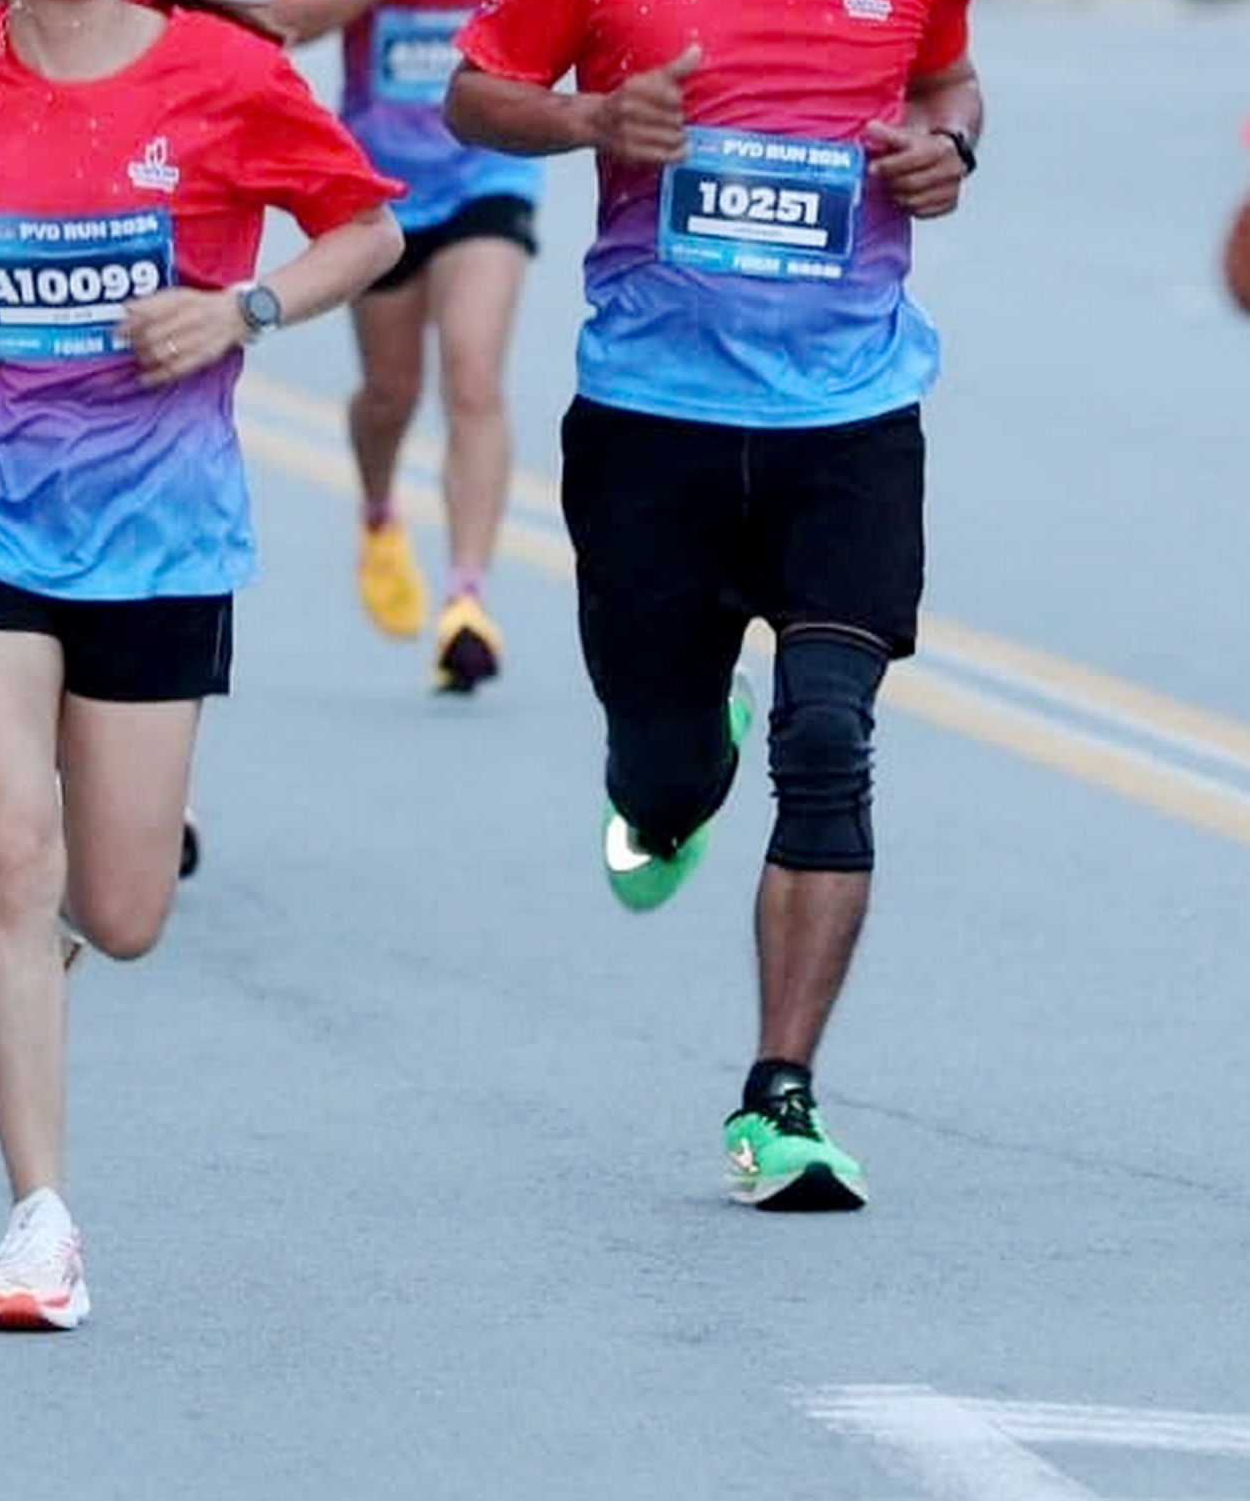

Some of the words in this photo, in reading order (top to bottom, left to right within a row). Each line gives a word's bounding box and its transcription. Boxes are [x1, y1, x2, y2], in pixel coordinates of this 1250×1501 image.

[721, 138, 764, 159] PVD
[765, 143, 807, 163] RUN
[699, 181, 820, 225] 10251
[19, 221, 61, 241] PVD
[63, 220, 107, 241] RUN
[109, 215, 159, 238] 2024
